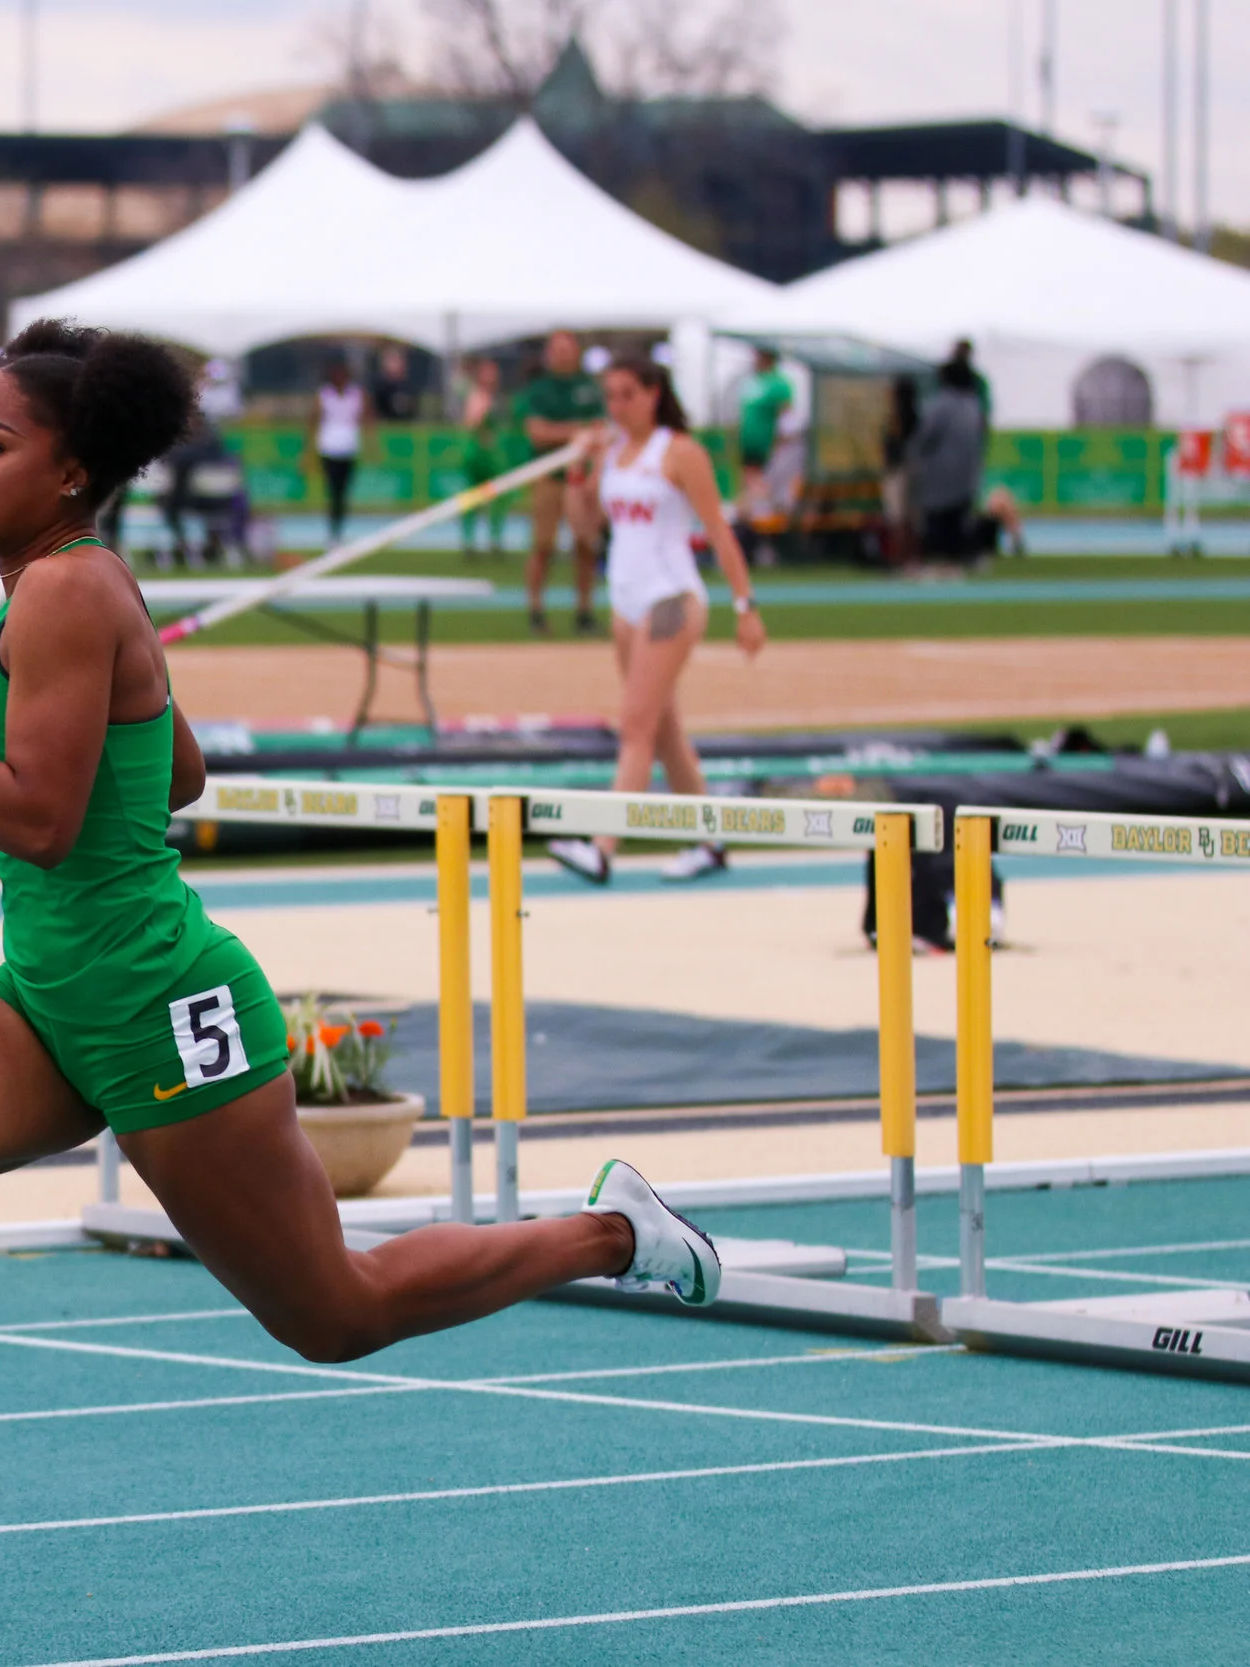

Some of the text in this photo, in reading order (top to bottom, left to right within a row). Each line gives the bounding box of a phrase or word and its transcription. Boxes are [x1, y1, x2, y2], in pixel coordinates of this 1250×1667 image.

[532, 803, 562, 819] GILL
[626, 803, 696, 829] BAYLOR
[721, 807, 785, 834] BEARS
[853, 817, 875, 834] GI
[1002, 824, 1038, 842] GILL
[1111, 824, 1192, 854] BAYLOR
[1220, 829, 1250, 857] BE
[188, 995, 230, 1078] 5
[1152, 1327, 1203, 1355] GILL
